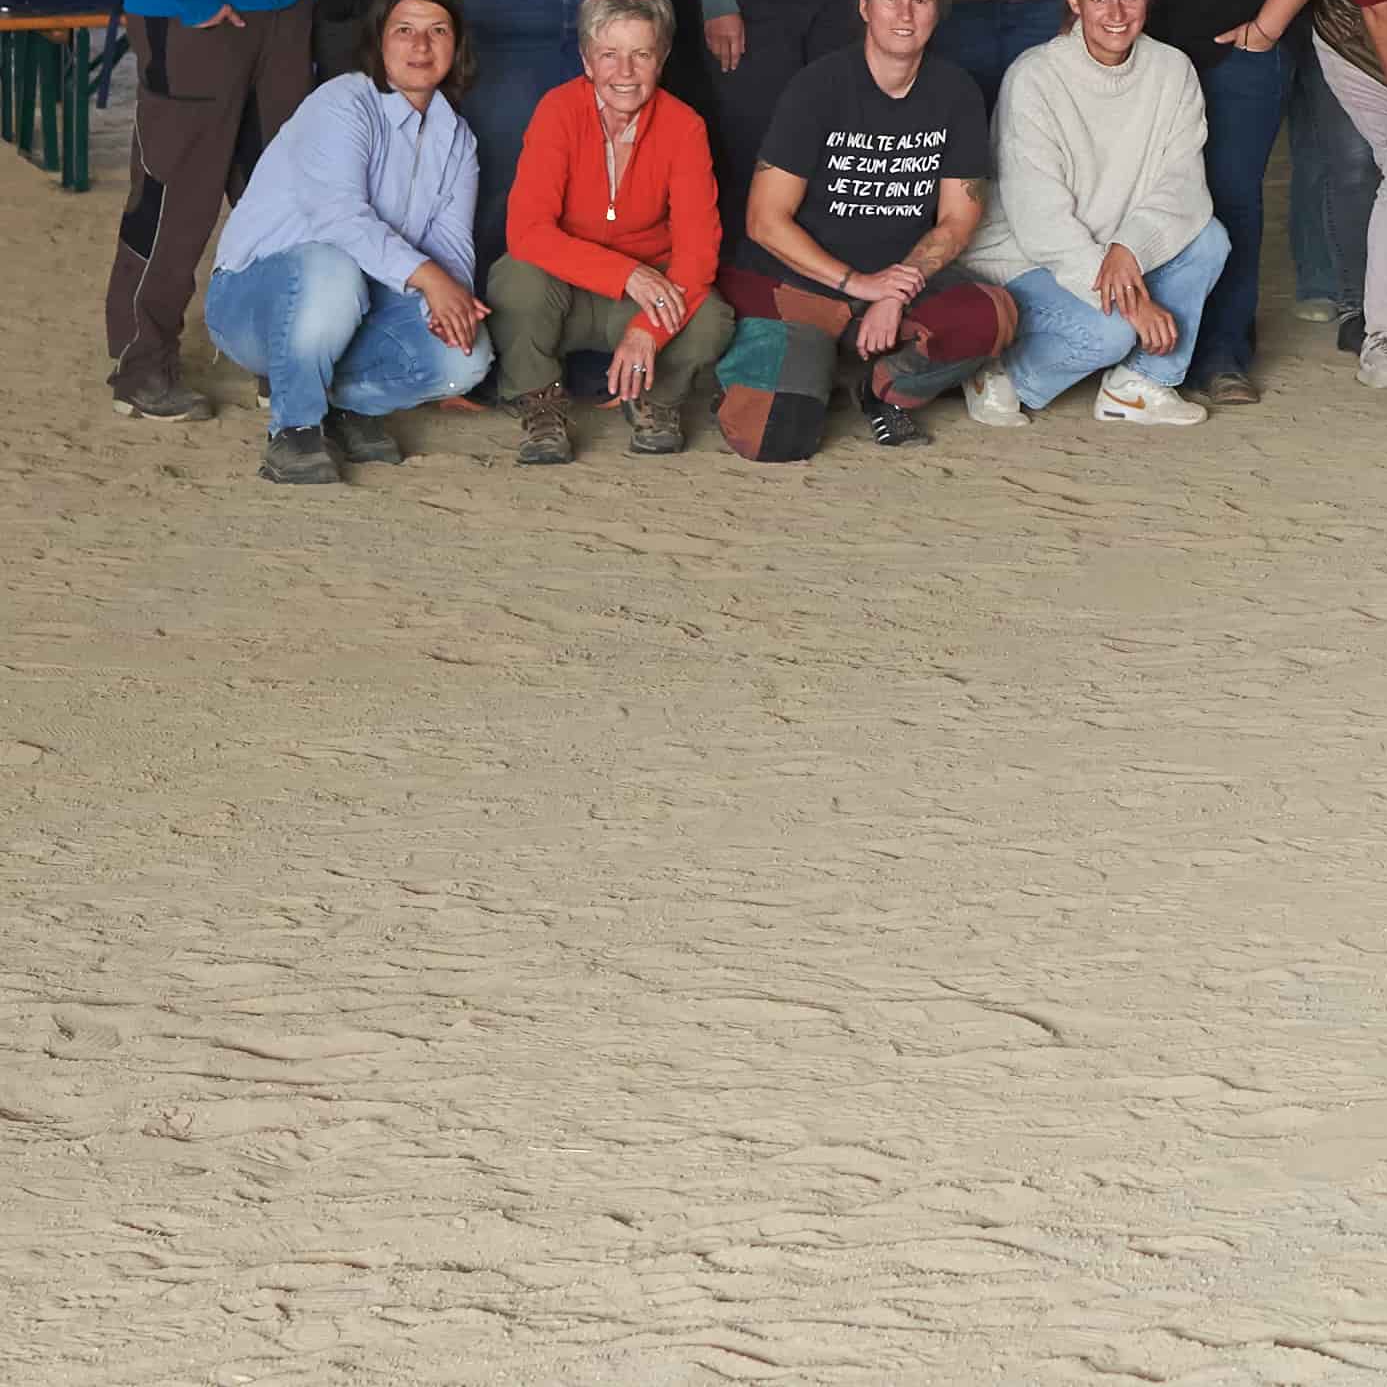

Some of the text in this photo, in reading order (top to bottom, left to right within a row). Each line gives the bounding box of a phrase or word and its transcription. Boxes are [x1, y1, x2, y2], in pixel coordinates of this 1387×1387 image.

[826, 131, 846, 148] ICH
[896, 132, 923, 151] ALS
[827, 153, 941, 174] NIE ZUM ZIRKUS
[828, 177, 936, 198] JETZT BIN ICH
